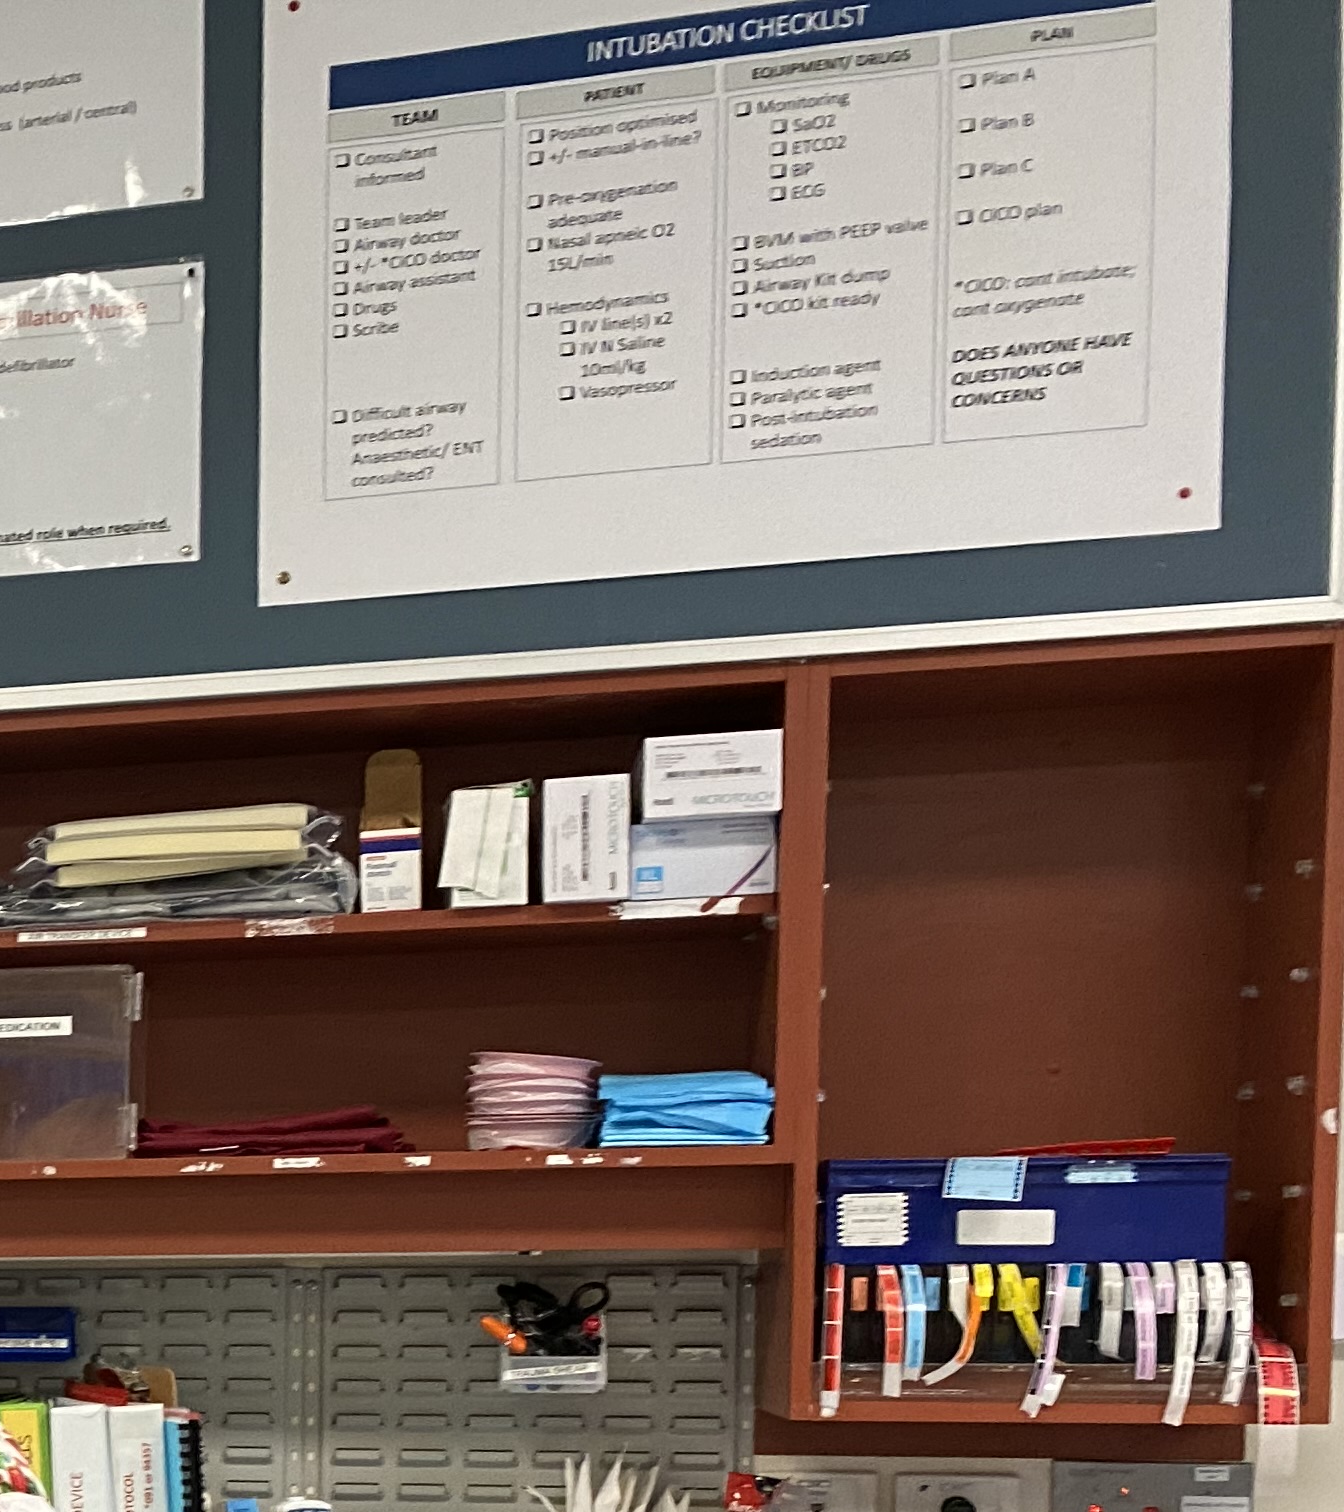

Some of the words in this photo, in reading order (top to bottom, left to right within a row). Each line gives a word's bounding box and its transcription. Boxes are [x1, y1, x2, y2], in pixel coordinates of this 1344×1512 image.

[586, 24, 734, 62] INTUBATION
[740, 5, 870, 42] CHECKLIST
[1030, 27, 1074, 42] PLAN
[856, 50, 911, 66] DRUGS
[982, 70, 1019, 86] Plan
[1022, 68, 1036, 82] A
[584, 82, 645, 102] PATIENT
[392, 109, 438, 126] TEAM
[981, 116, 1018, 130] Plan
[1022, 112, 1035, 126] B
[791, 135, 846, 154] ETCO2
[791, 162, 814, 177] BP
[980, 162, 1018, 176] Plan
[1021, 158, 1033, 172] C
[791, 183, 826, 200] ECG
[355, 217, 395, 230] Team
[399, 208, 448, 225] leader
[1024, 202, 1063, 220] plan
[548, 232, 591, 250] Nasal
[651, 223, 675, 238] O2
[754, 254, 816, 272] Suction
[89, 300, 148, 320] Nurse
[353, 302, 397, 315] Drugs
[352, 322, 399, 336] Scribe
[952, 346, 1000, 363] DOES
[1002, 337, 1081, 358] ANYONE
[1083, 332, 1133, 350] HAVE
[952, 363, 1055, 386] QUESTIONS
[1056, 360, 1084, 376] OR
[580, 379, 677, 399] Vasopressor
[950, 387, 1047, 408] CONCERNS
[36, 527, 63, 540] role
[66, 524, 104, 538] when
[146, 1474, 154, 1484] or
